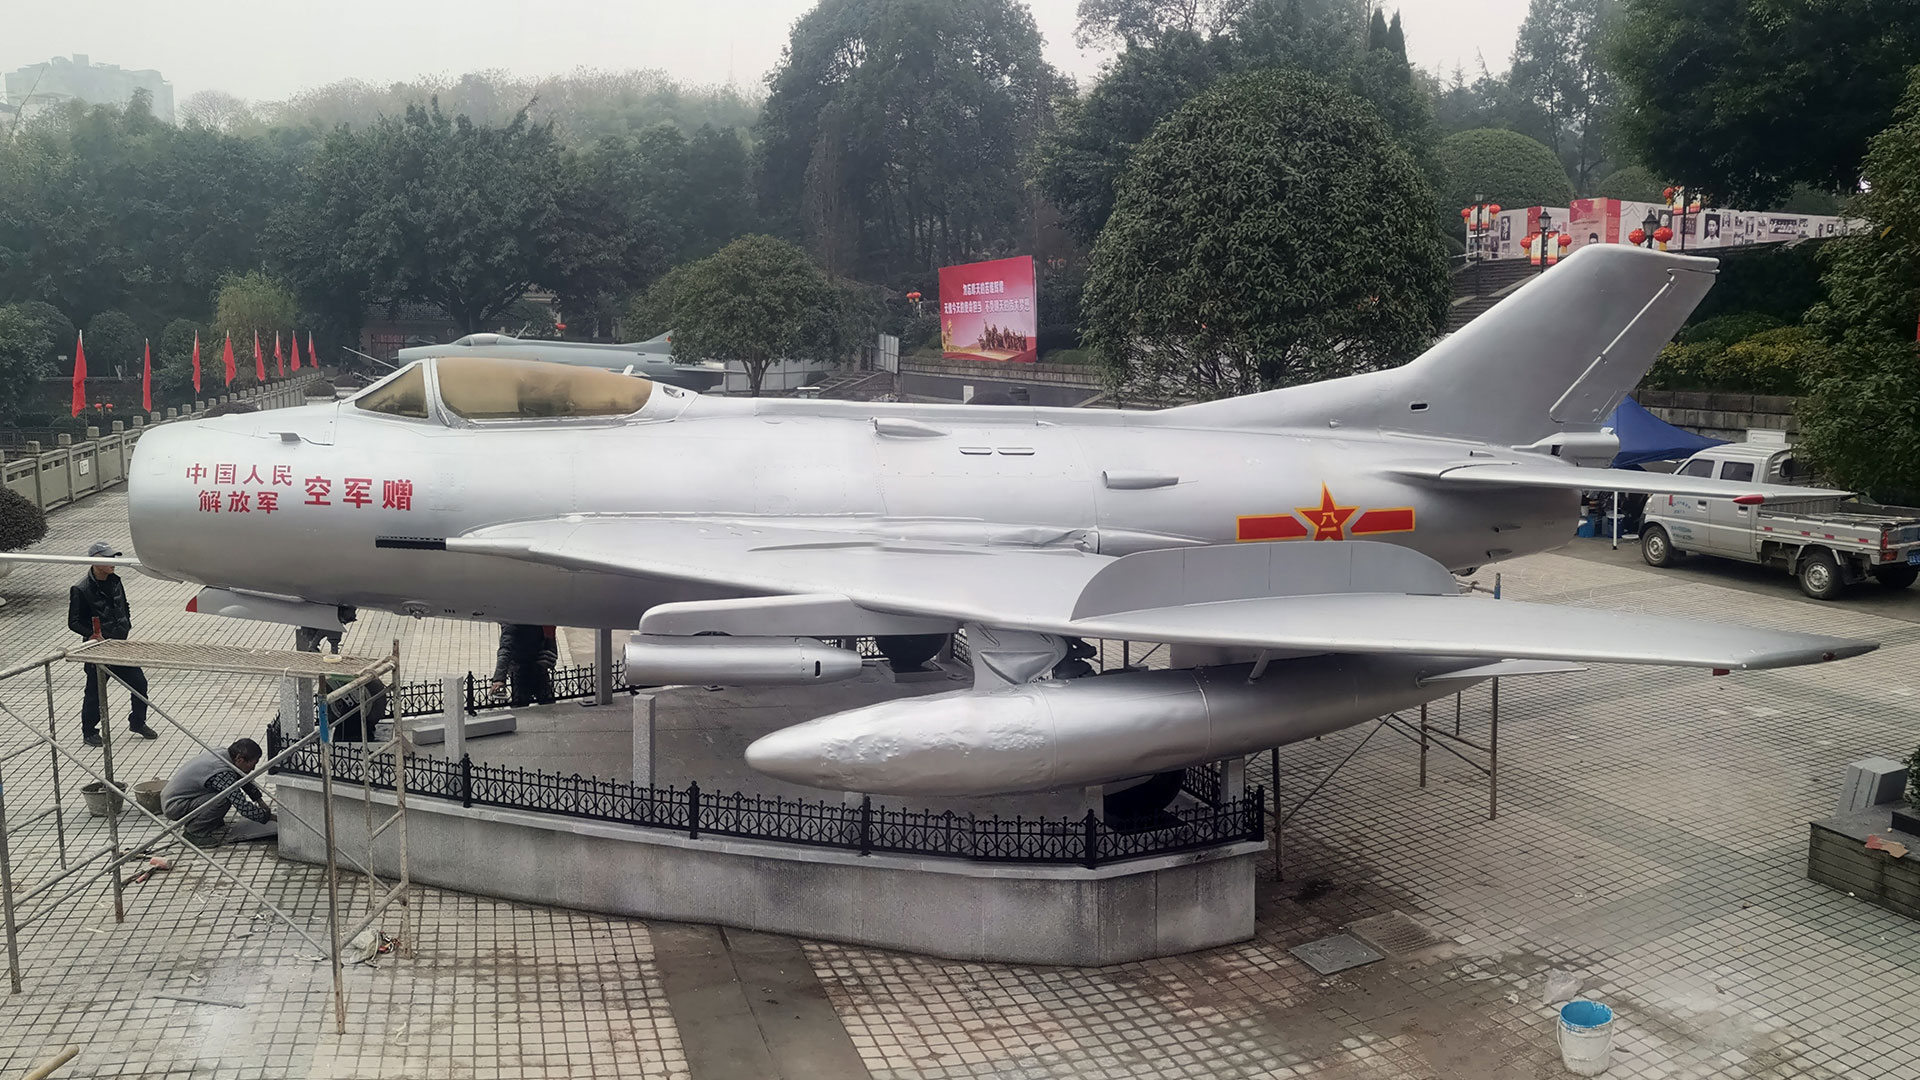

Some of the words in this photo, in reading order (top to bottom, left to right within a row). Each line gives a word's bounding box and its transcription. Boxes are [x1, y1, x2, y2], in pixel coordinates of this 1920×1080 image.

[186, 463, 293, 487] 中国人民
[198, 490, 279, 514] 解放军
[304, 475, 413, 511] 空军赠
[1320, 511, 1338, 532] 八一
